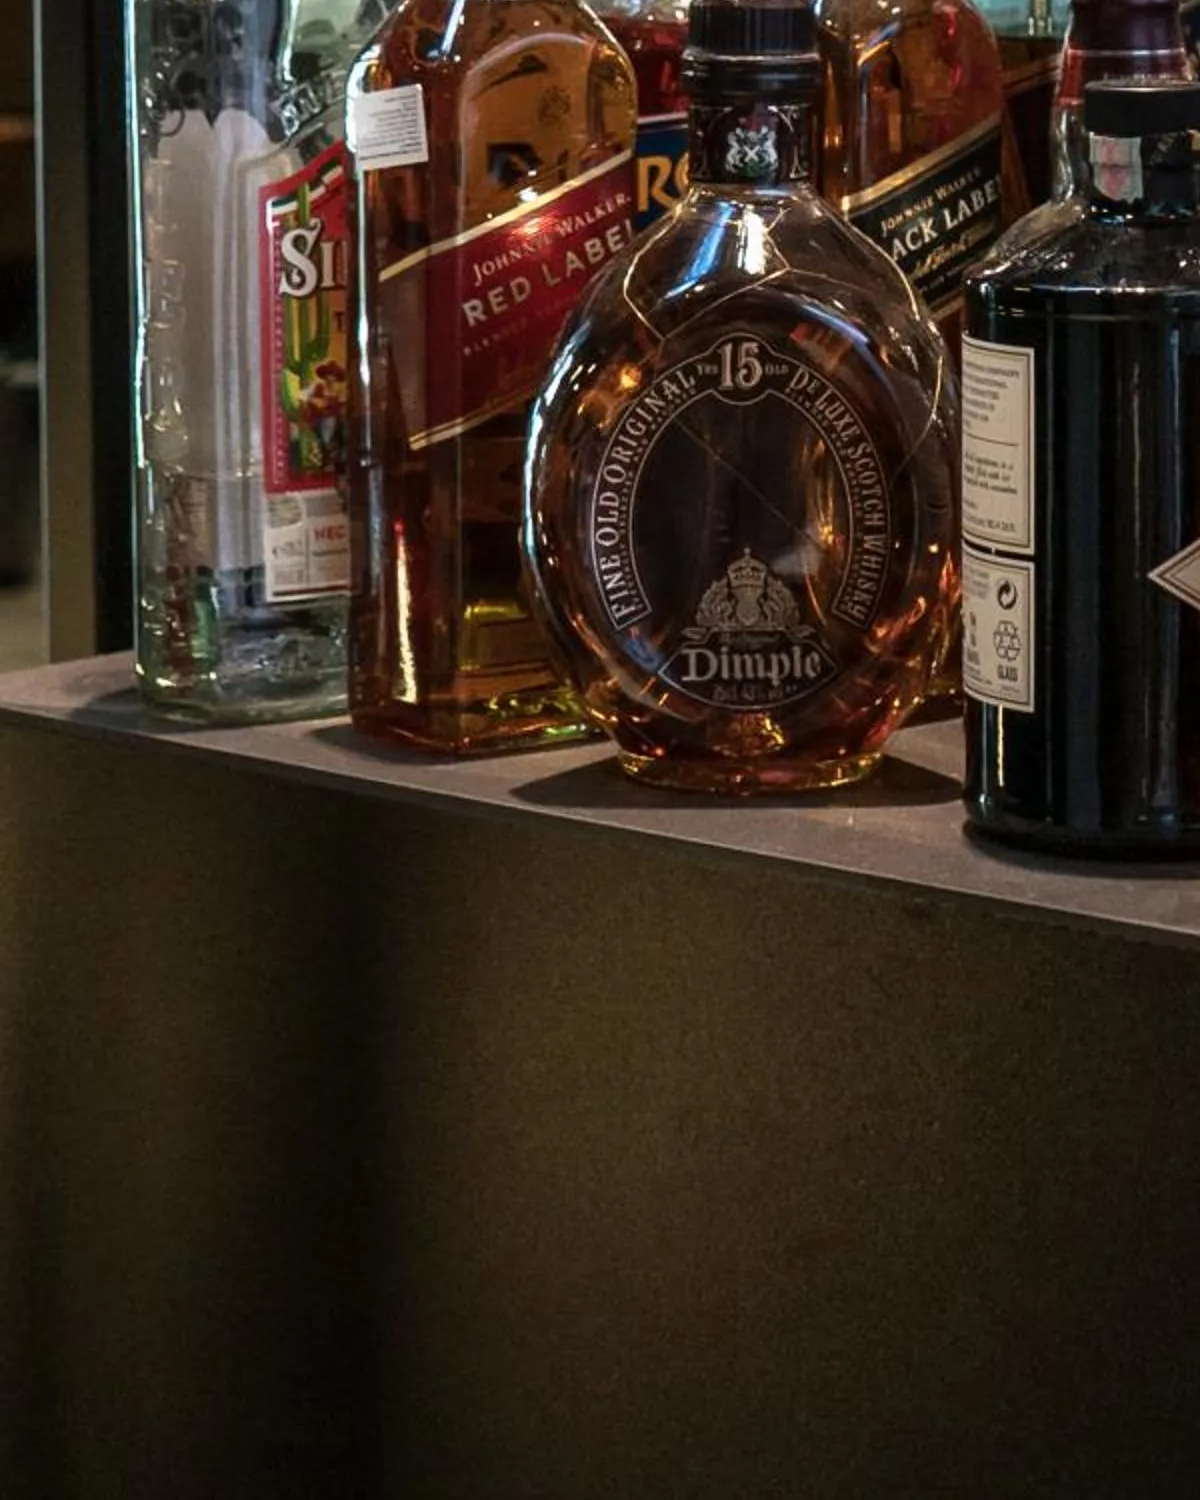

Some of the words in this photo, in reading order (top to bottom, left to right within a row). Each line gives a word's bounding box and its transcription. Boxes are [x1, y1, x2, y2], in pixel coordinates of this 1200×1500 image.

[891, 217, 938, 262] ACK
[463, 276, 531, 327] RED
[717, 341, 763, 390] 15
[603, 370, 696, 484] ORIGINAL
[814, 388, 861, 441] LUXE
[847, 442, 886, 526] SCOTCH
[595, 491, 620, 547] OLD
[600, 554, 637, 620] FINE
[849, 534, 887, 620] WHISKY
[681, 645, 822, 688] Dimple
